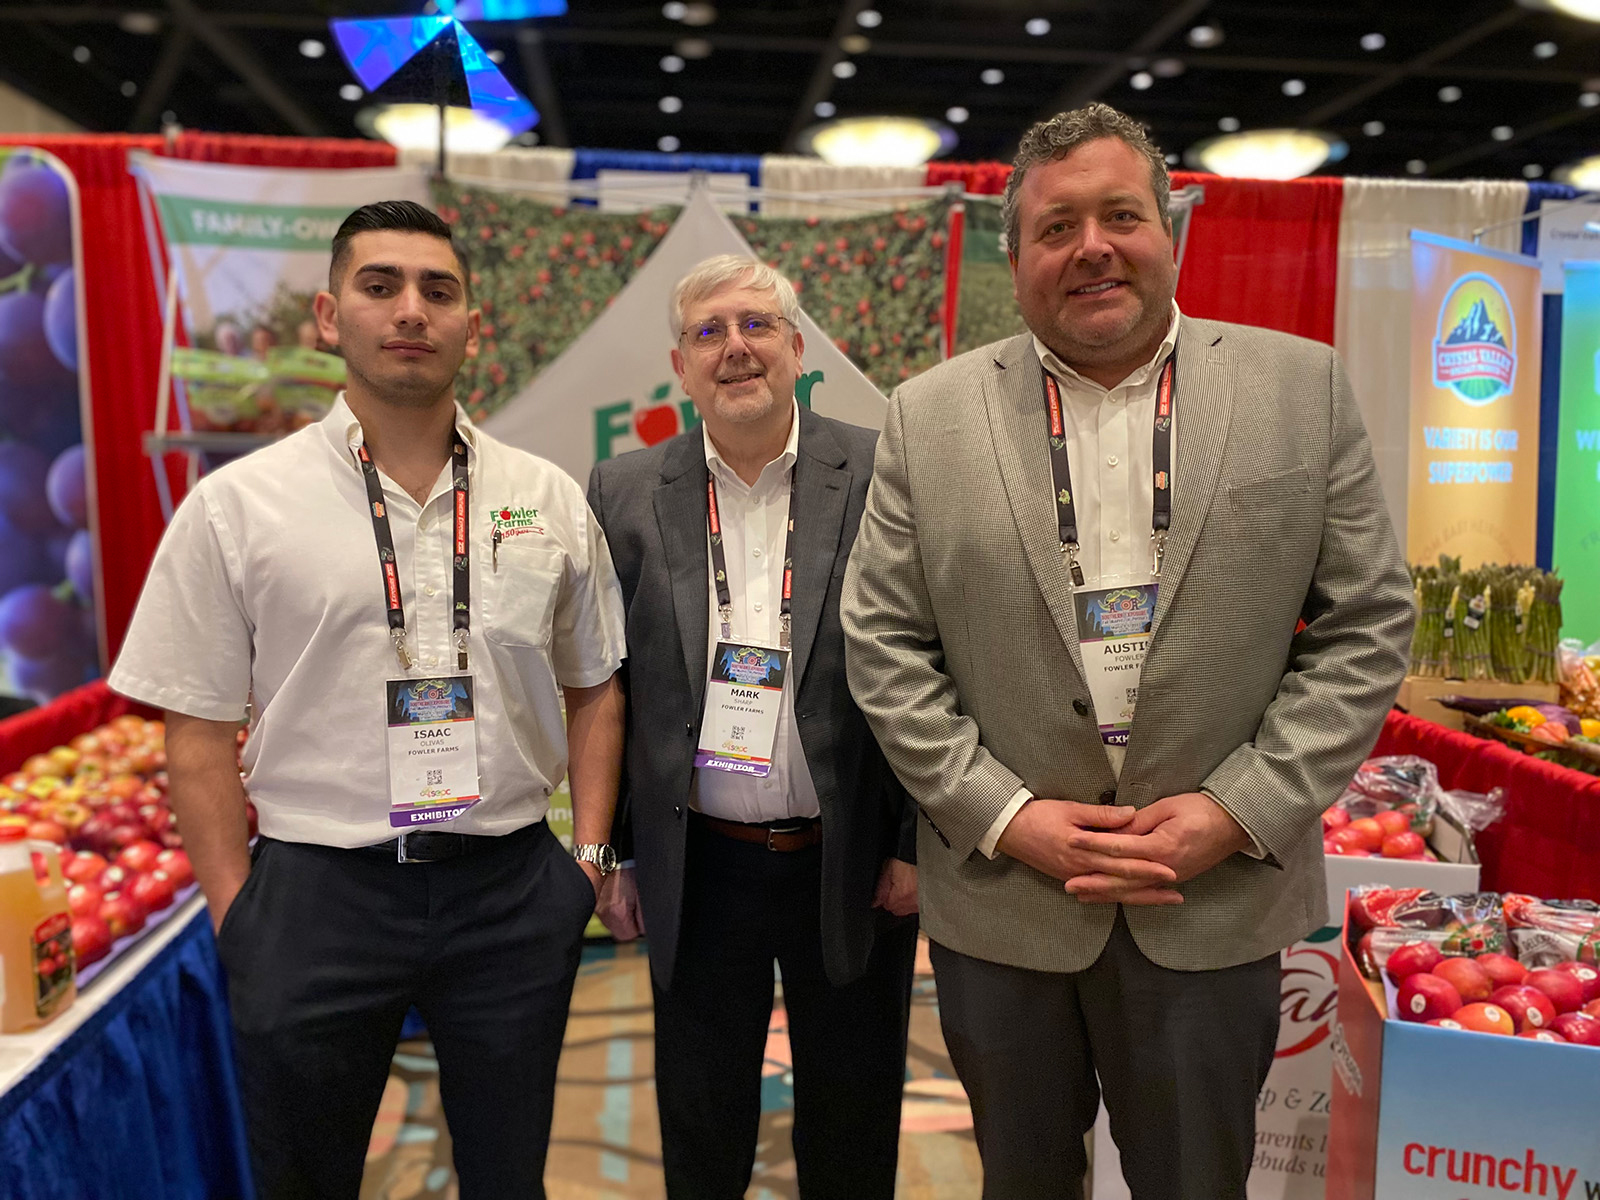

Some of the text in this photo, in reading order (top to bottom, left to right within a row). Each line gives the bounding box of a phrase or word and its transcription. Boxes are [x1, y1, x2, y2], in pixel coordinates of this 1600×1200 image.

[1423, 427, 1518, 452] VARIETY IS OUR
[1429, 461, 1513, 484] SUPERPOWER
[496, 519, 534, 529] Farms
[1104, 663, 1134, 672] FOWLER
[730, 688, 760, 700] MARK
[721, 704, 745, 712] FOWLER
[414, 727, 451, 739] ISAAC
[420, 739, 445, 747] OLIVAS
[408, 748, 436, 756] FOWLER
[705, 759, 755, 772] EXHIBITOR
[1403, 1142, 1578, 1200] crunchy
